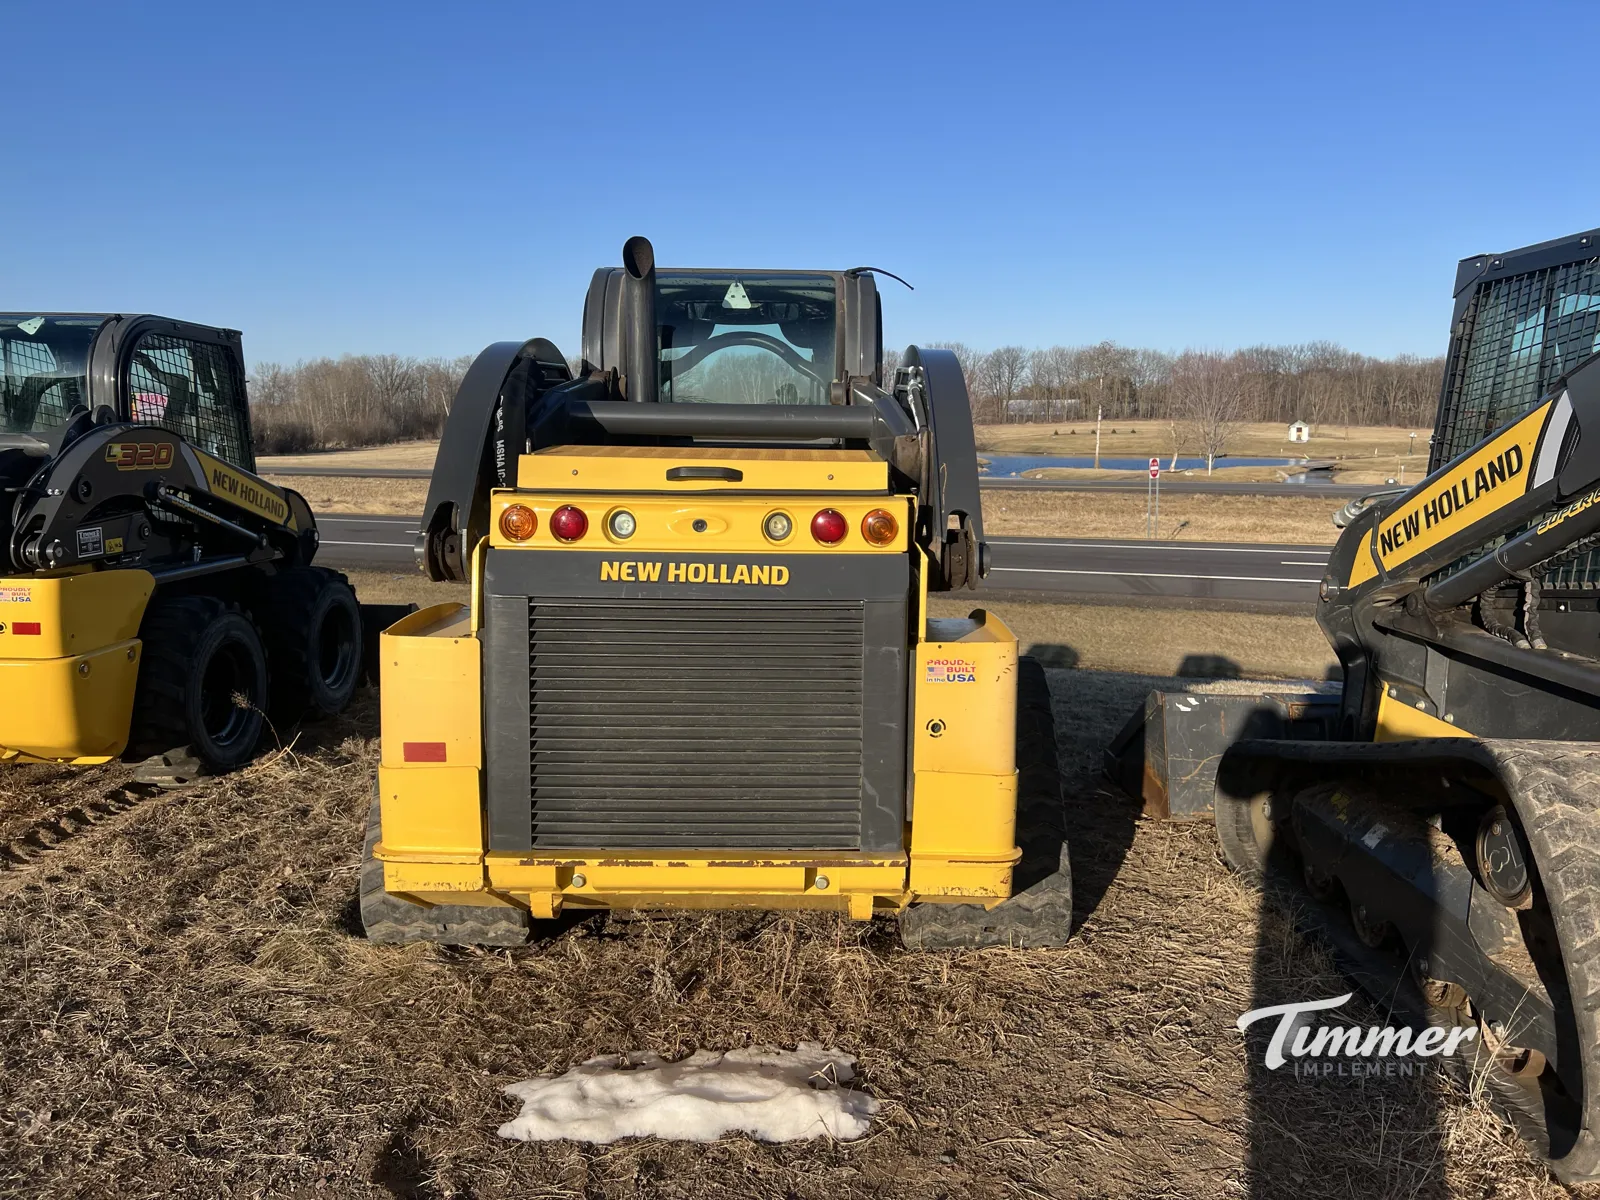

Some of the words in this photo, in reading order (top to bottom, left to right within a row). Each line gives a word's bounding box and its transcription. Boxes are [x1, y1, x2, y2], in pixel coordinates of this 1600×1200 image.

[105, 443, 175, 470] L320
[496, 440, 505, 468] MSHA
[212, 468, 239, 495] NEW
[240, 482, 285, 518] HOLLAND
[1380, 509, 1420, 557] NEW
[1423, 443, 1523, 530] HOLLAND
[1537, 492, 1594, 535] SUPER
[601, 561, 663, 581] NEW
[667, 562, 790, 586] HOLLAND
[946, 674, 976, 682] USA
